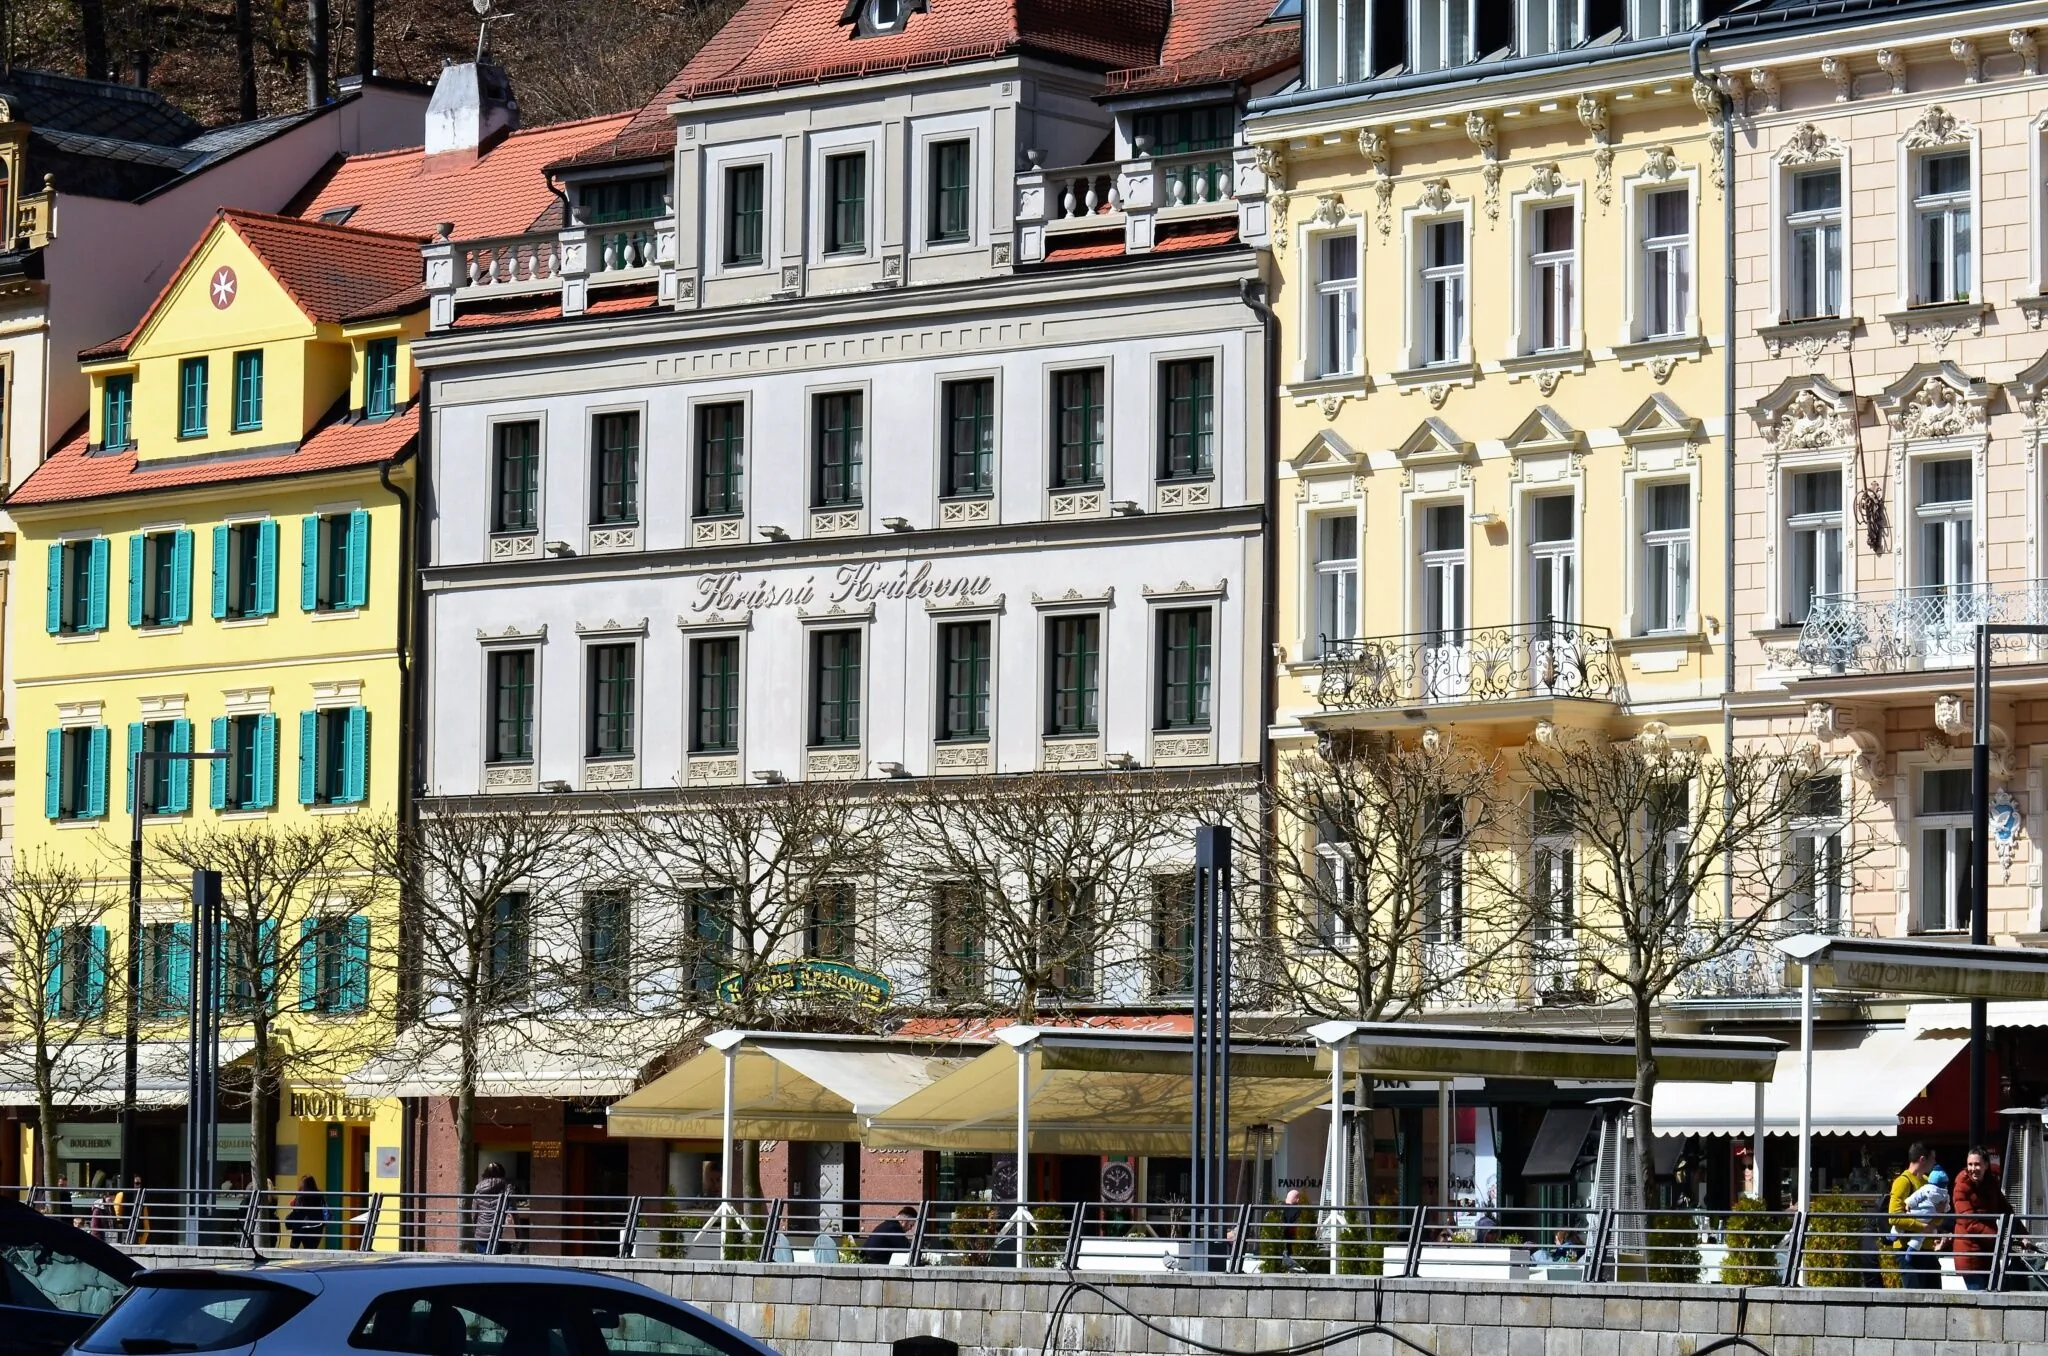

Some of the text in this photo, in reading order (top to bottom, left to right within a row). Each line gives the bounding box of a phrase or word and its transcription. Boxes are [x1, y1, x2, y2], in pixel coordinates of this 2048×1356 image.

[1848, 963, 1912, 983] MATTONI
[290, 1091, 373, 1117] HOTEL
[70, 1139, 112, 1148] BOUCHERON
[1278, 1177, 1323, 1188] PANDORA
